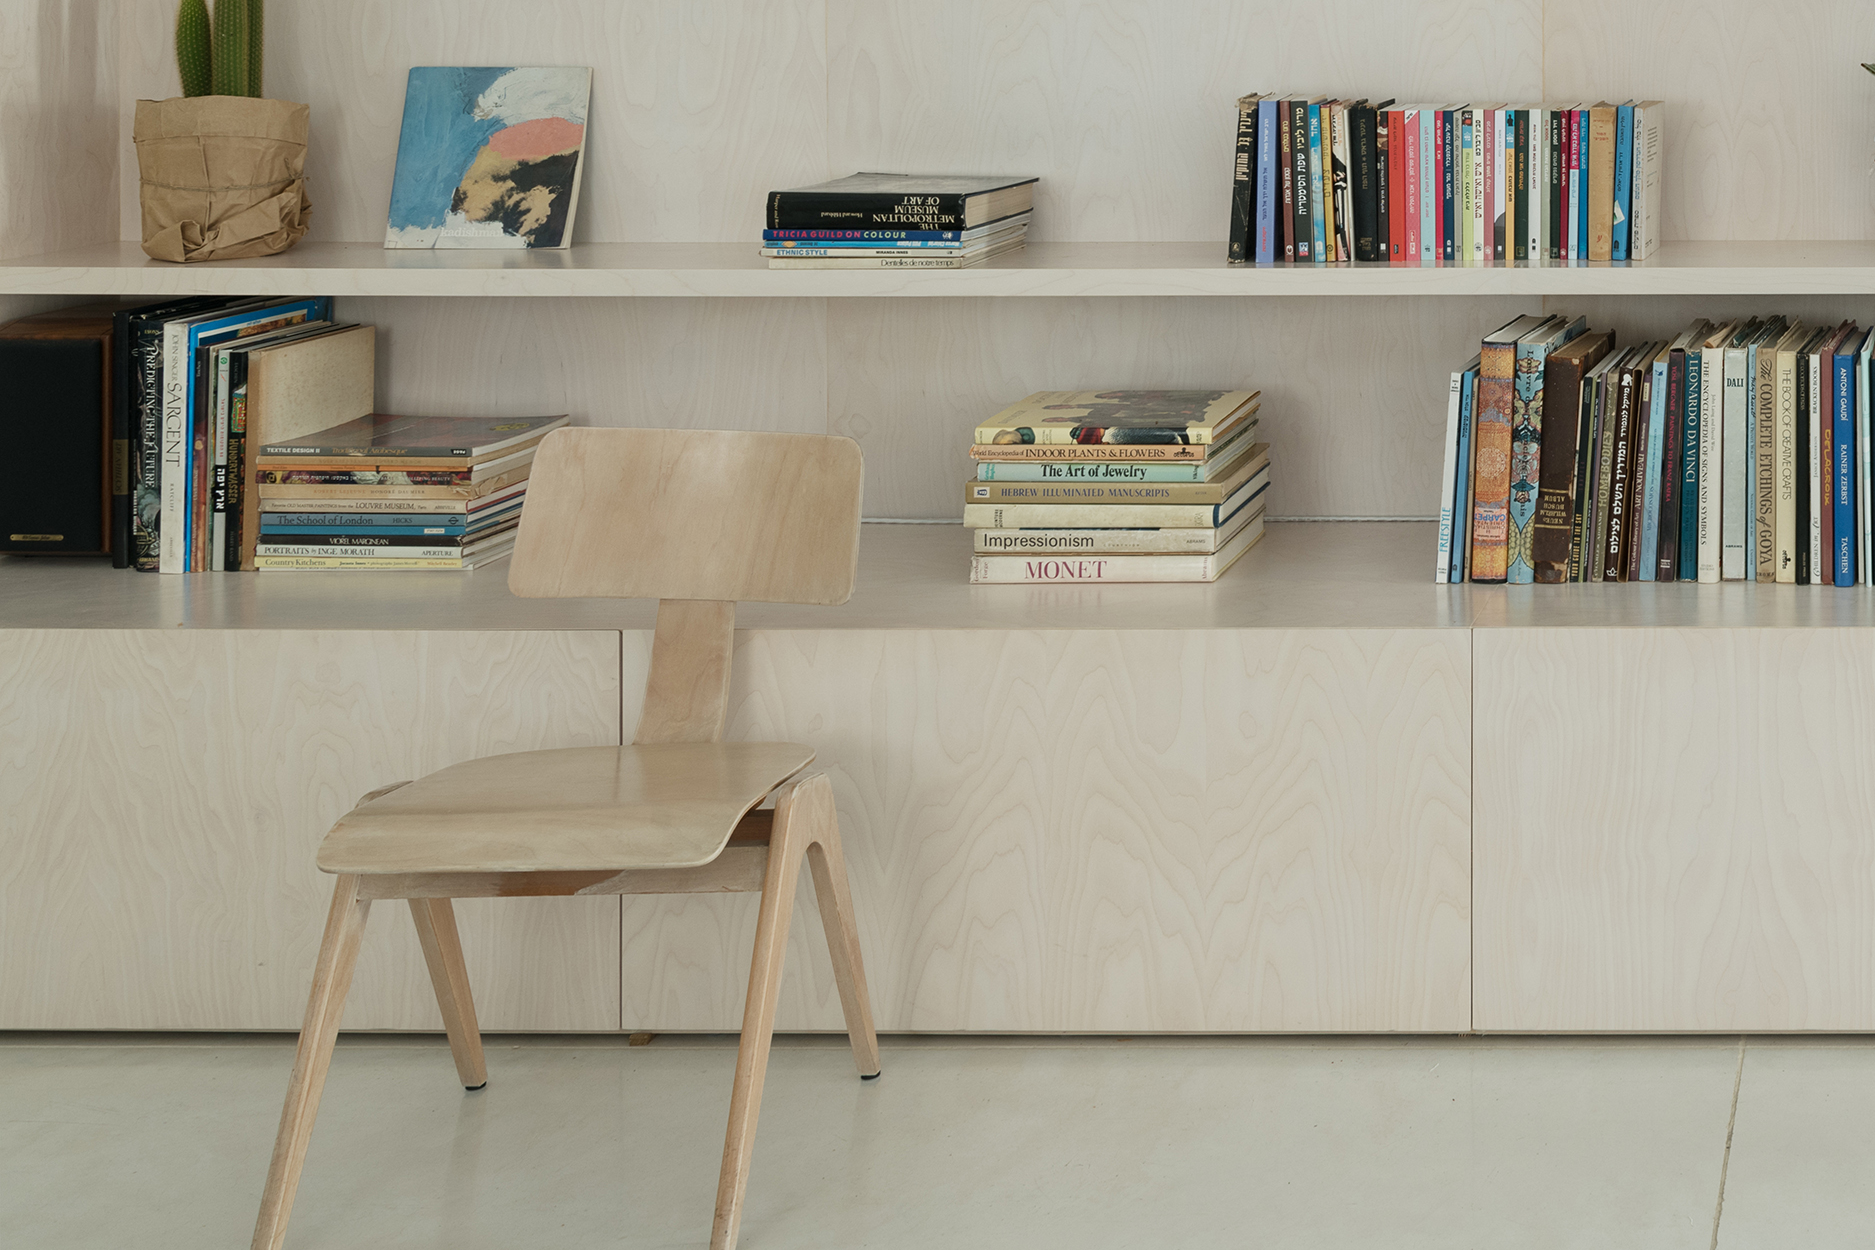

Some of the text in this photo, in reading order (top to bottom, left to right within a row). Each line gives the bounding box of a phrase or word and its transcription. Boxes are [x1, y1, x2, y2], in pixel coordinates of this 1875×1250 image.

[902, 196, 940, 205] OF ART
[894, 205, 939, 213] MUSEUM
[872, 214, 955, 223] METROPOLITAN
[773, 231, 906, 239] TRICIA GUILD ON COLOUR
[171, 355, 179, 382] SINGER
[1726, 377, 1745, 388] DALI
[1840, 398, 1848, 421] GAUDÍ
[166, 382, 182, 468] SARGENT
[1685, 360, 1698, 483] LEONARDO DA VINCI
[1782, 368, 1791, 500] THE BOOK OF CREATIVE CRAFTS
[1025, 449, 1166, 457] INDOOR PLANTS & FLOWERS
[1702, 445, 1708, 457] OF
[1755, 358, 1772, 566] The COMPLETE ETCHINGS of GOYA
[1041, 464, 1147, 480] The Art of Jewelry
[1634, 453, 1644, 509] ART NOUVEAU
[1001, 488, 1170, 497] HEBREW ILLUMINATED MANUSCRIPTS
[277, 515, 374, 524] The School of London
[1439, 507, 1451, 553] FREESTYLE
[983, 533, 1095, 550] Impressionism
[264, 547, 375, 556] PORTRAITS by INGE MORATH
[265, 559, 295, 567] Country
[1025, 560, 1107, 579] MONET
